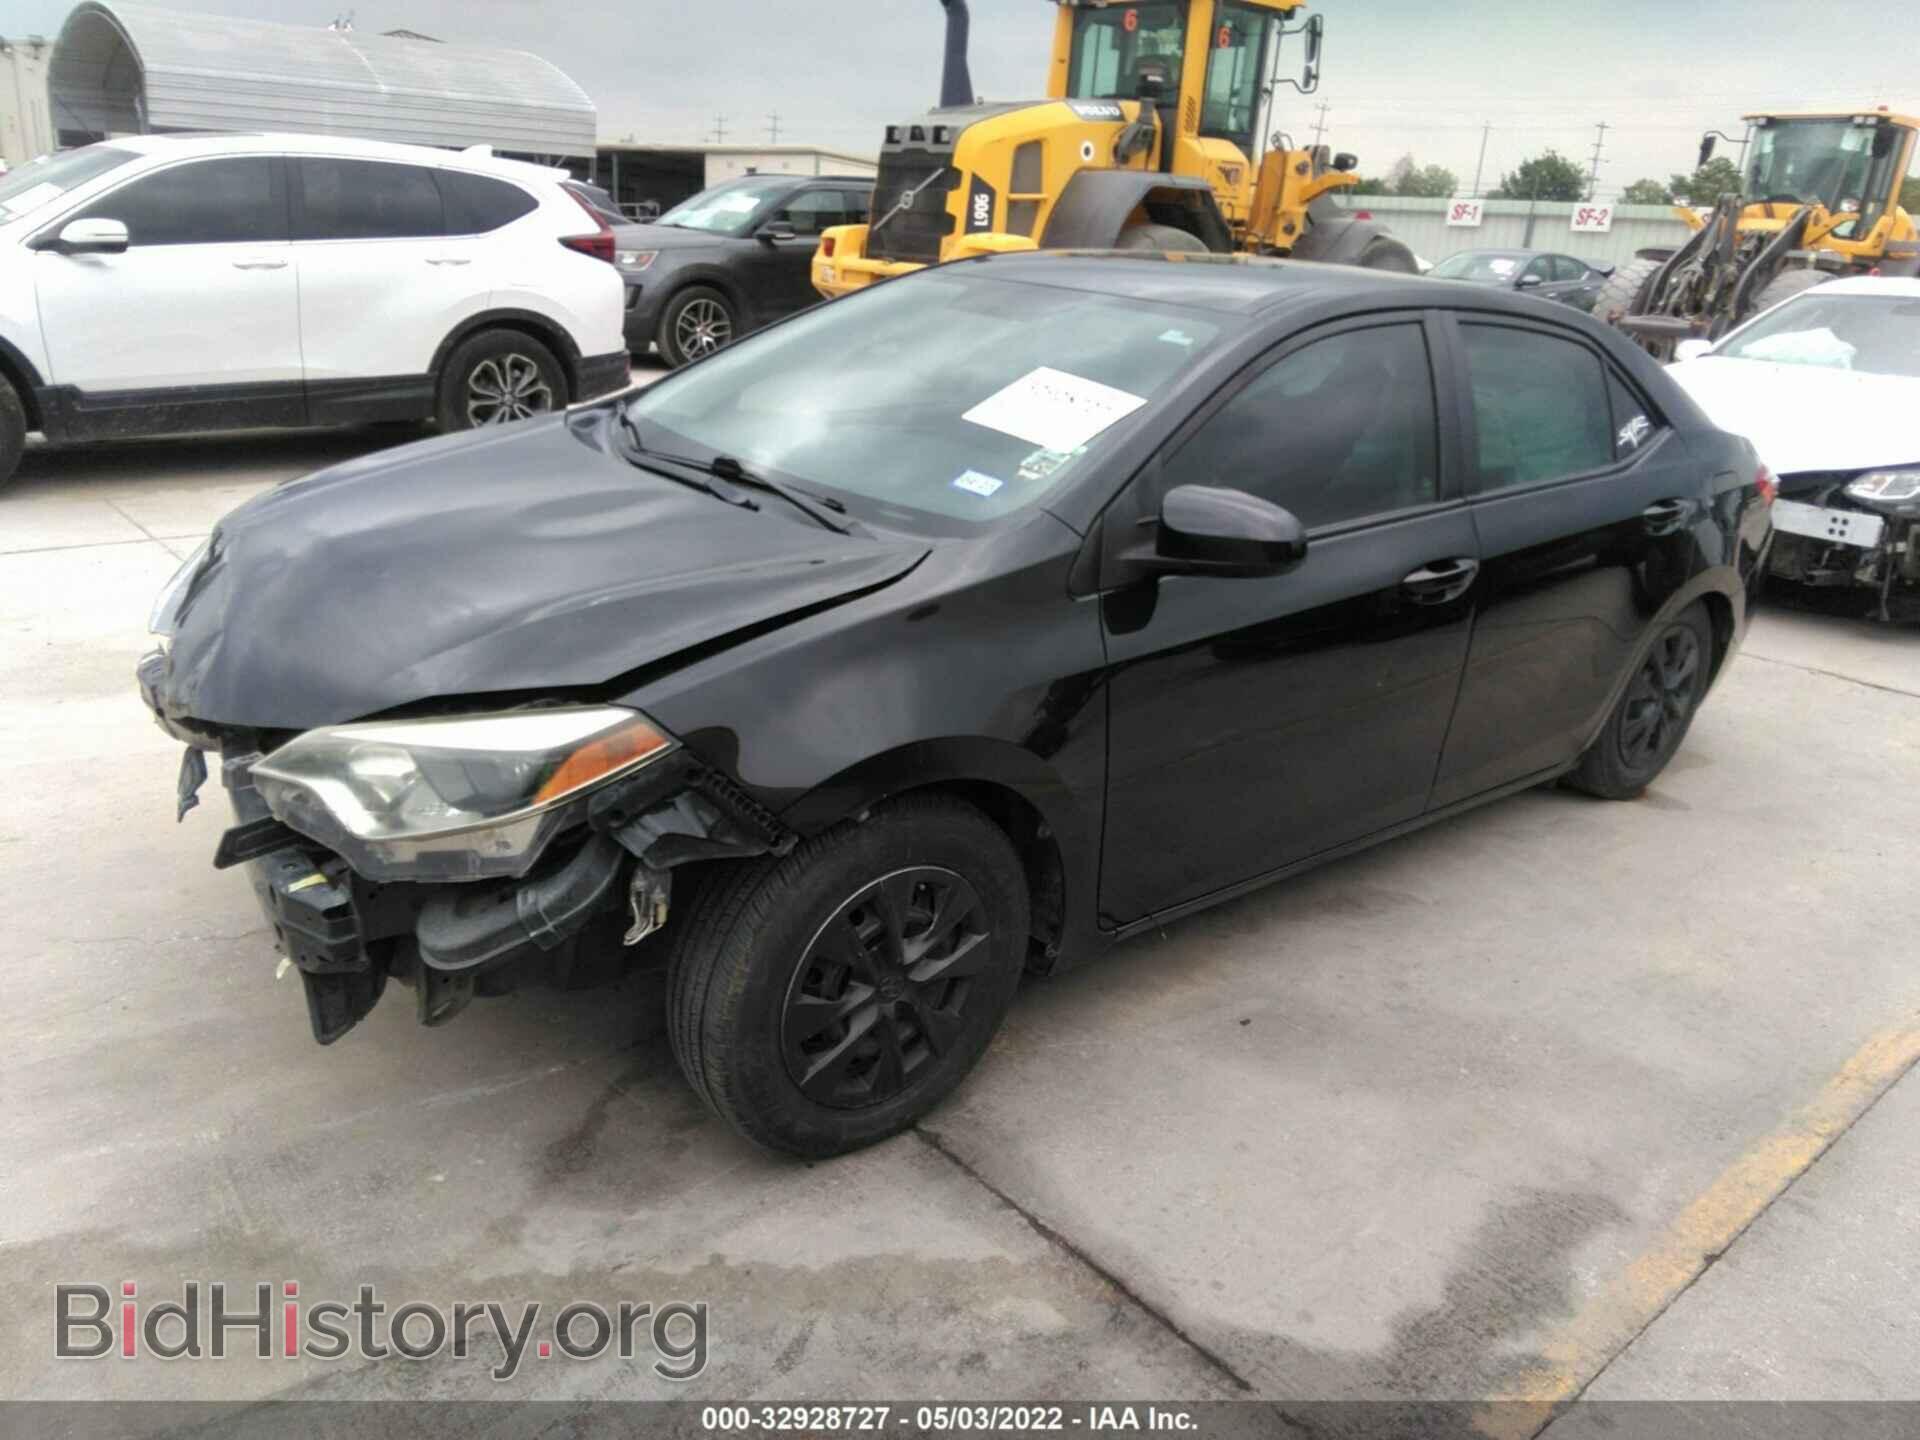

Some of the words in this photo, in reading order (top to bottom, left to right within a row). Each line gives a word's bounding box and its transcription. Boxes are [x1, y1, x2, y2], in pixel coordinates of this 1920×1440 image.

[1123, 9, 1138, 32] 6
[1218, 26, 1231, 48] 6
[973, 193, 990, 227] L90G
[1452, 204, 1479, 221] SF-1
[1576, 208, 1609, 226] SF-2
